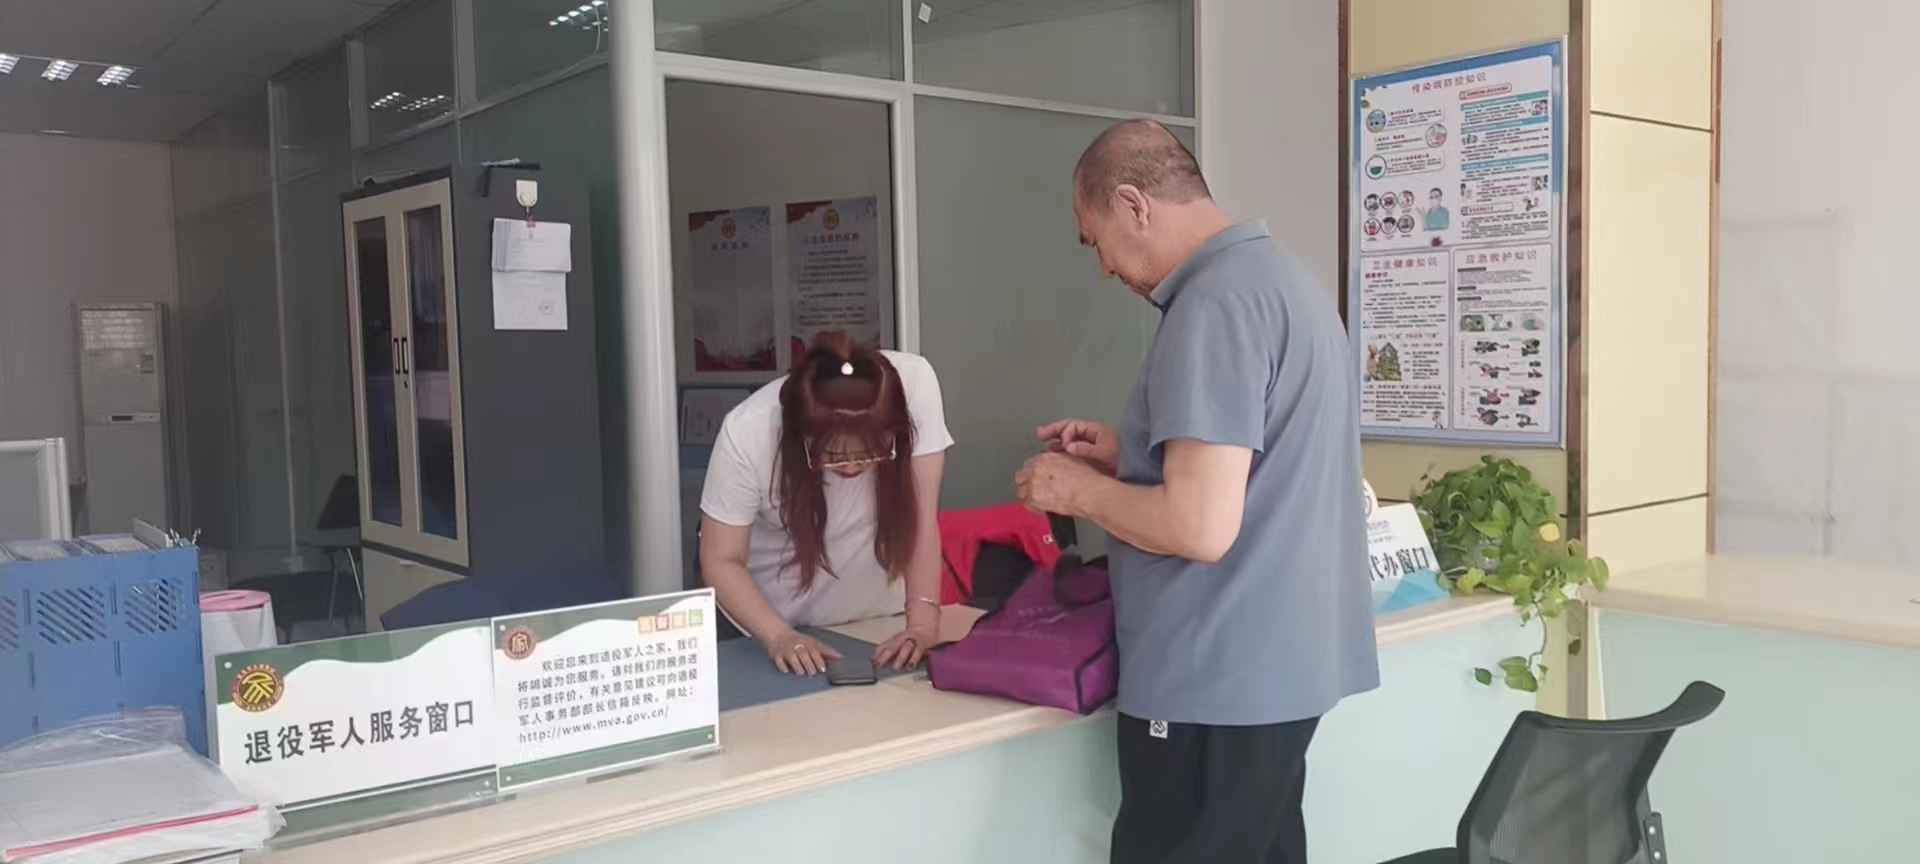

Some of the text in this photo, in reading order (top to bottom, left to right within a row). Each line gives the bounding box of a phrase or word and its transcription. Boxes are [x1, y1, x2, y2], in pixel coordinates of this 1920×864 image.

[1465, 250, 1537, 265] 应急救护知识
[243, 700, 474, 765] 退役军人服务窗口
[518, 704, 669, 743] http://www.mva.gov.cn/
